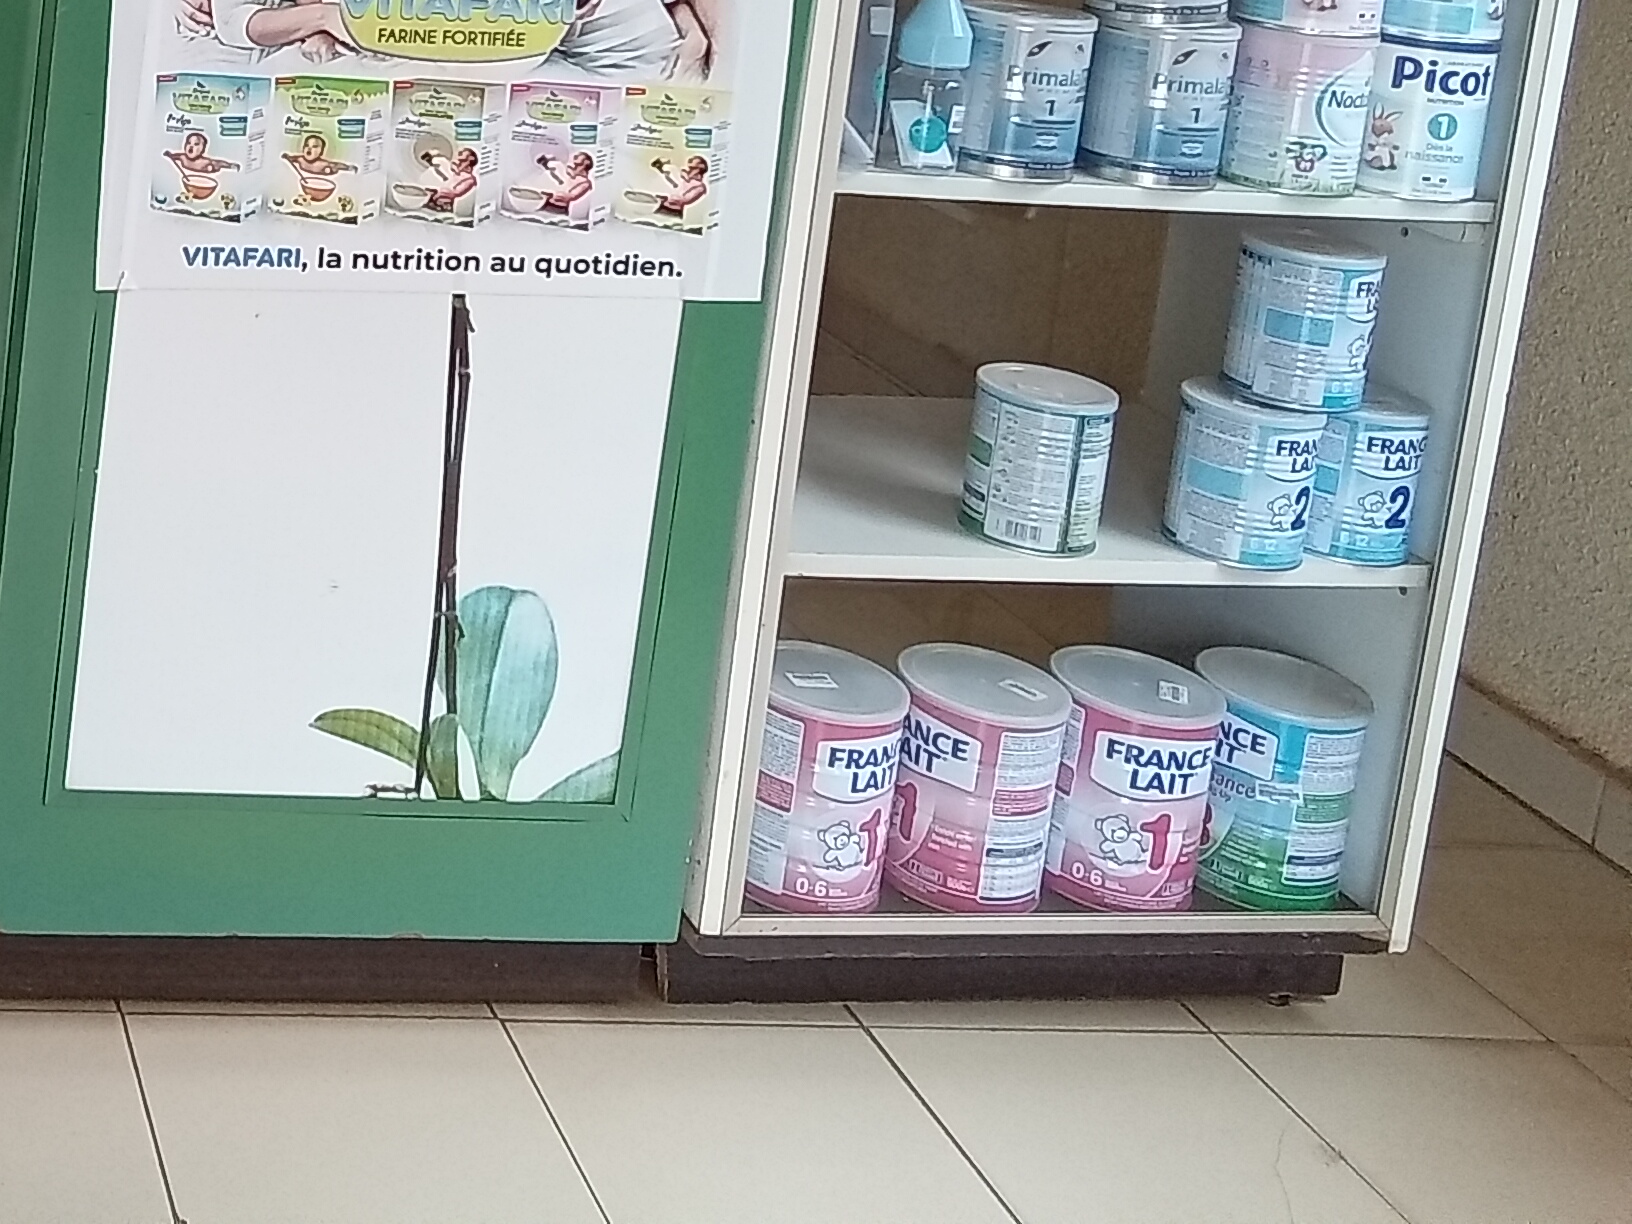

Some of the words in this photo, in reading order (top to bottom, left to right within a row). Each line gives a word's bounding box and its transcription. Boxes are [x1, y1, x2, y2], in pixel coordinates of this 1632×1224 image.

[377, 27, 437, 45] FARINE
[442, 28, 527, 48] FORTIFIÉE
[1045, 100, 1058, 117] 1
[1190, 107, 1202, 124] 1
[1438, 116, 1451, 140] 1
[181, 246, 308, 273] VITAFARI,
[317, 247, 342, 270] la
[352, 248, 481, 273] nutrition
[490, 255, 526, 274] au
[534, 253, 684, 280] quotidien.
[1290, 485, 1311, 531] 2
[1384, 484, 1410, 529] 2
[1105, 737, 1211, 770] FRANCE
[1128, 769, 1196, 794] LAIT
[859, 808, 882, 868] 1
[1140, 813, 1172, 872] 1
